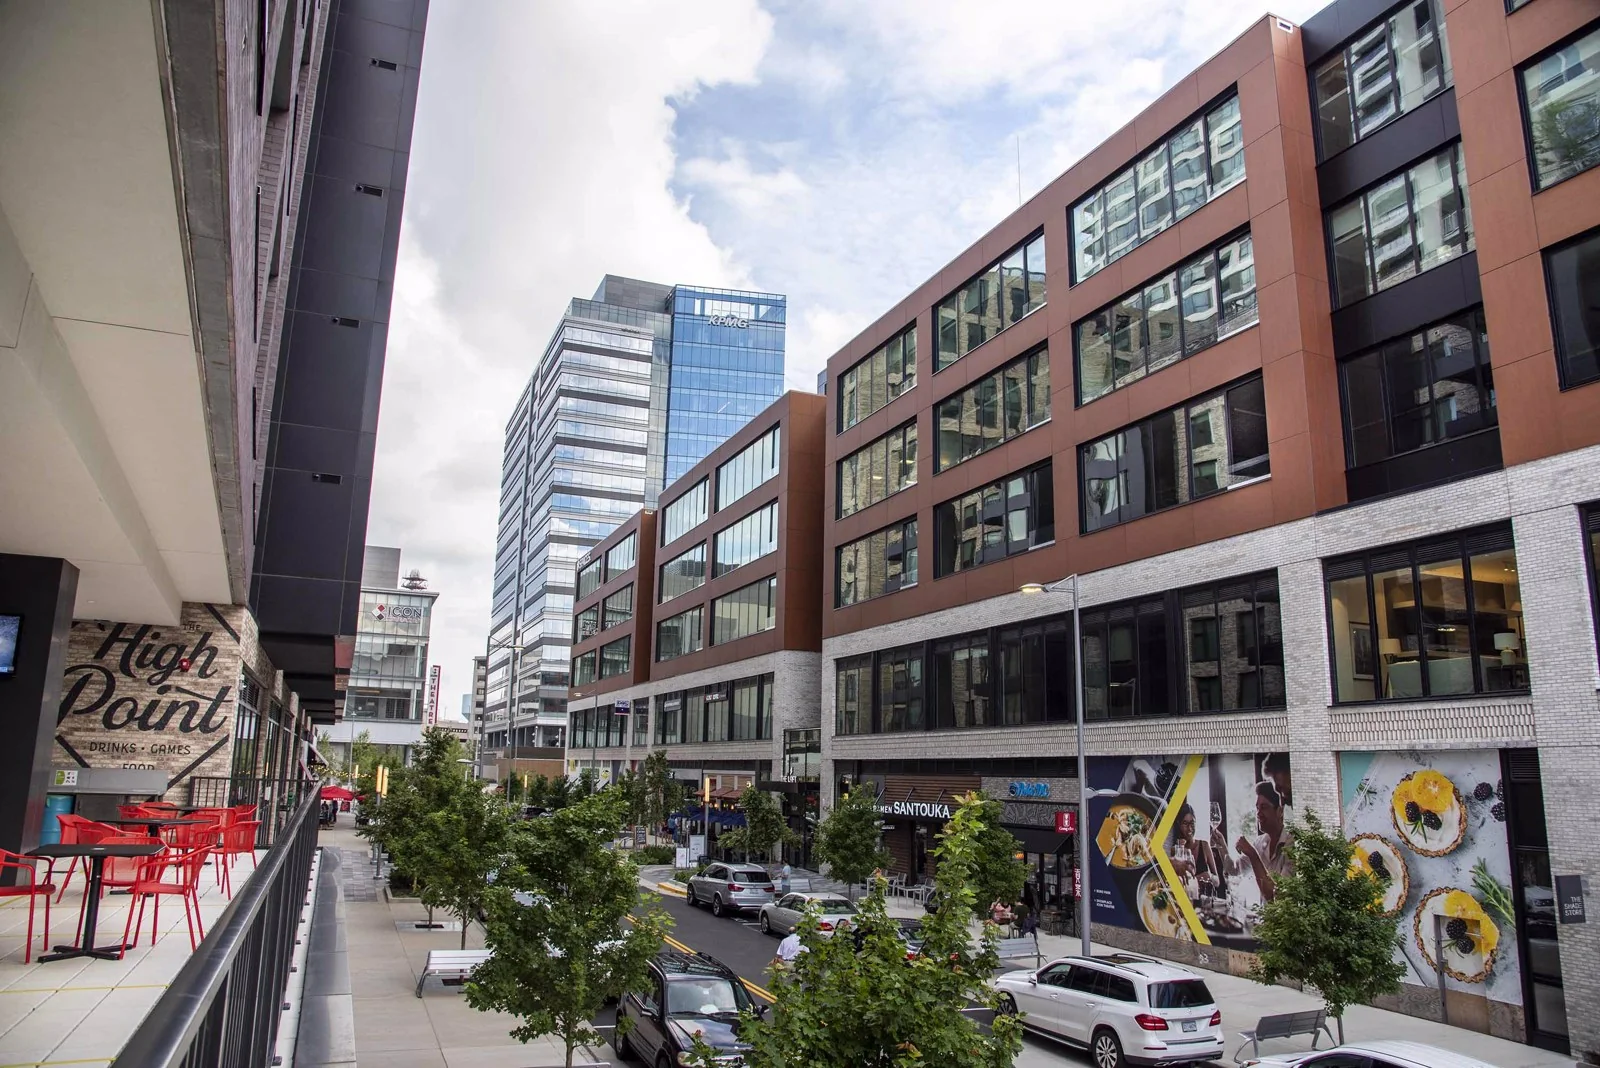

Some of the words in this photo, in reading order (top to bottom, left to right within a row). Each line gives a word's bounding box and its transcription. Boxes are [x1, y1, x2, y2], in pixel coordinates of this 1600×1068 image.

[708, 315, 749, 328] KPMG
[388, 606, 422, 618] ICON
[94, 624, 218, 686] High
[56, 664, 233, 734] Point
[428, 678, 437, 724] THEATRE
[89, 742, 137, 753] DRINKS
[151, 744, 191, 755] GAMES
[894, 802, 950, 818] SANTOUKA
